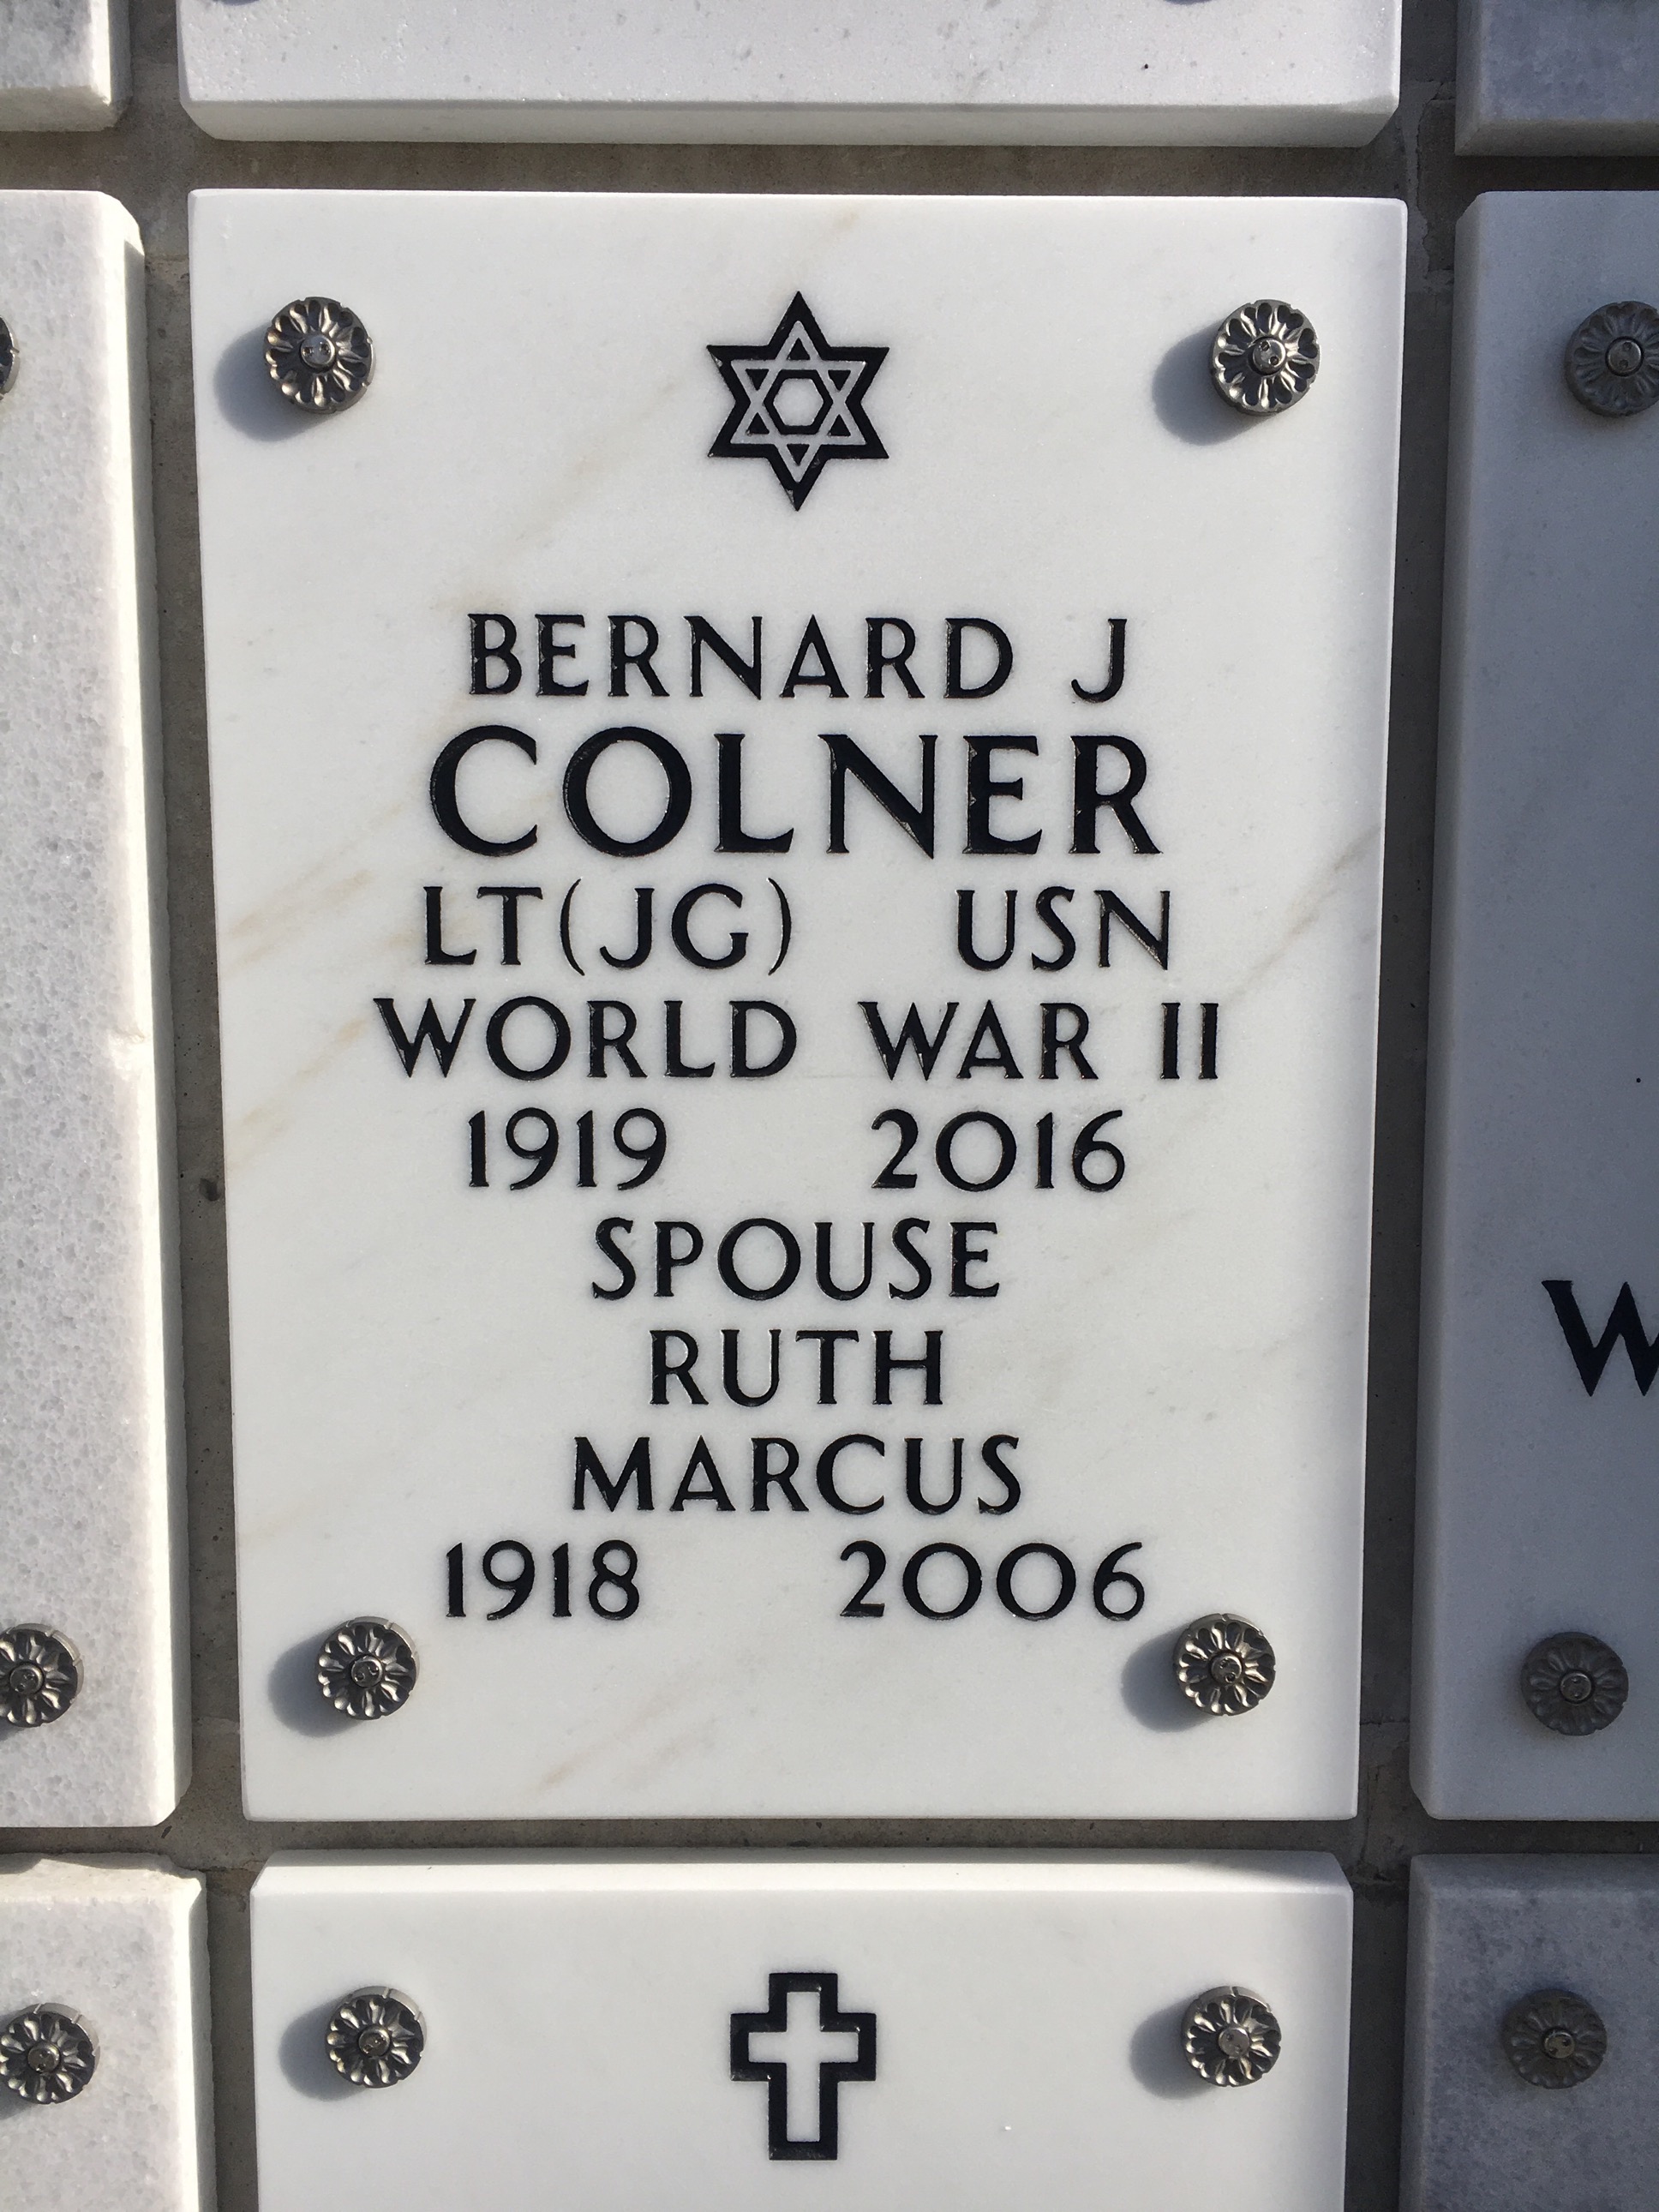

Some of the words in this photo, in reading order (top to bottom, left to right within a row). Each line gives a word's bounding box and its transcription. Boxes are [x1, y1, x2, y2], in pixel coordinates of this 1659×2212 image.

[468, 613, 1013, 701] BERNARD
[1070, 619, 1128, 704] J
[429, 724, 1163, 860] COLNER
[423, 877, 793, 976] LT(JG)
[956, 885, 1171, 973] USN
[373, 995, 798, 1082] WORLD
[858, 999, 1099, 1082] WAR
[1159, 1002, 1219, 1081] II
[467, 1106, 668, 1191] 1919
[871, 1108, 1126, 1194] 2016
[591, 1216, 1000, 1302] SPOUSE
[649, 1328, 943, 1408] RUTH
[572, 1433, 1021, 1516] MARCUS
[446, 1539, 640, 1622] 1918
[839, 1539, 1146, 1622] 2006
